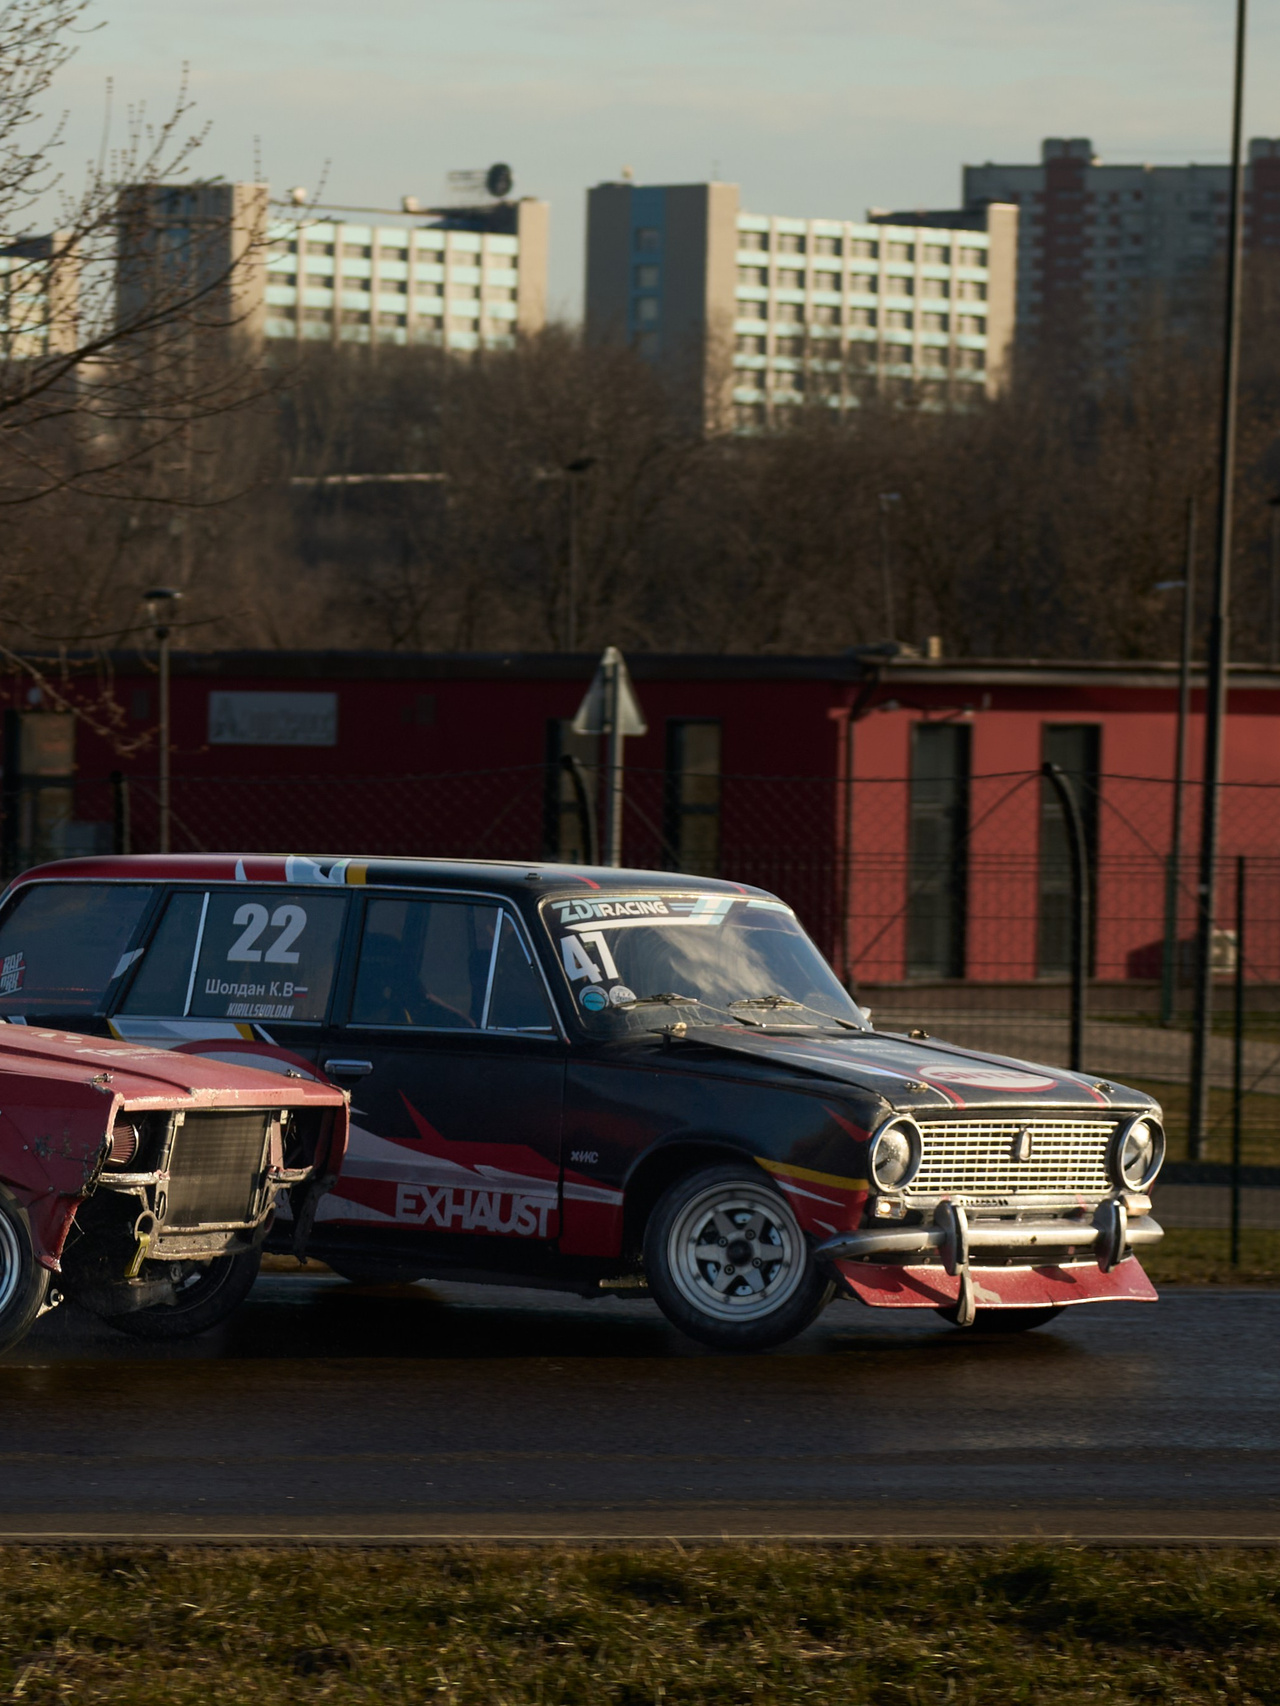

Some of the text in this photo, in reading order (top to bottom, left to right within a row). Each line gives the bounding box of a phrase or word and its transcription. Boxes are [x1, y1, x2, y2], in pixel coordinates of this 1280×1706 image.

[227, 902, 307, 964] 22
[560, 931, 619, 984] 47
[205, 979, 265, 997] Шолдан
[395, 1183, 558, 1237] EXHAUST
